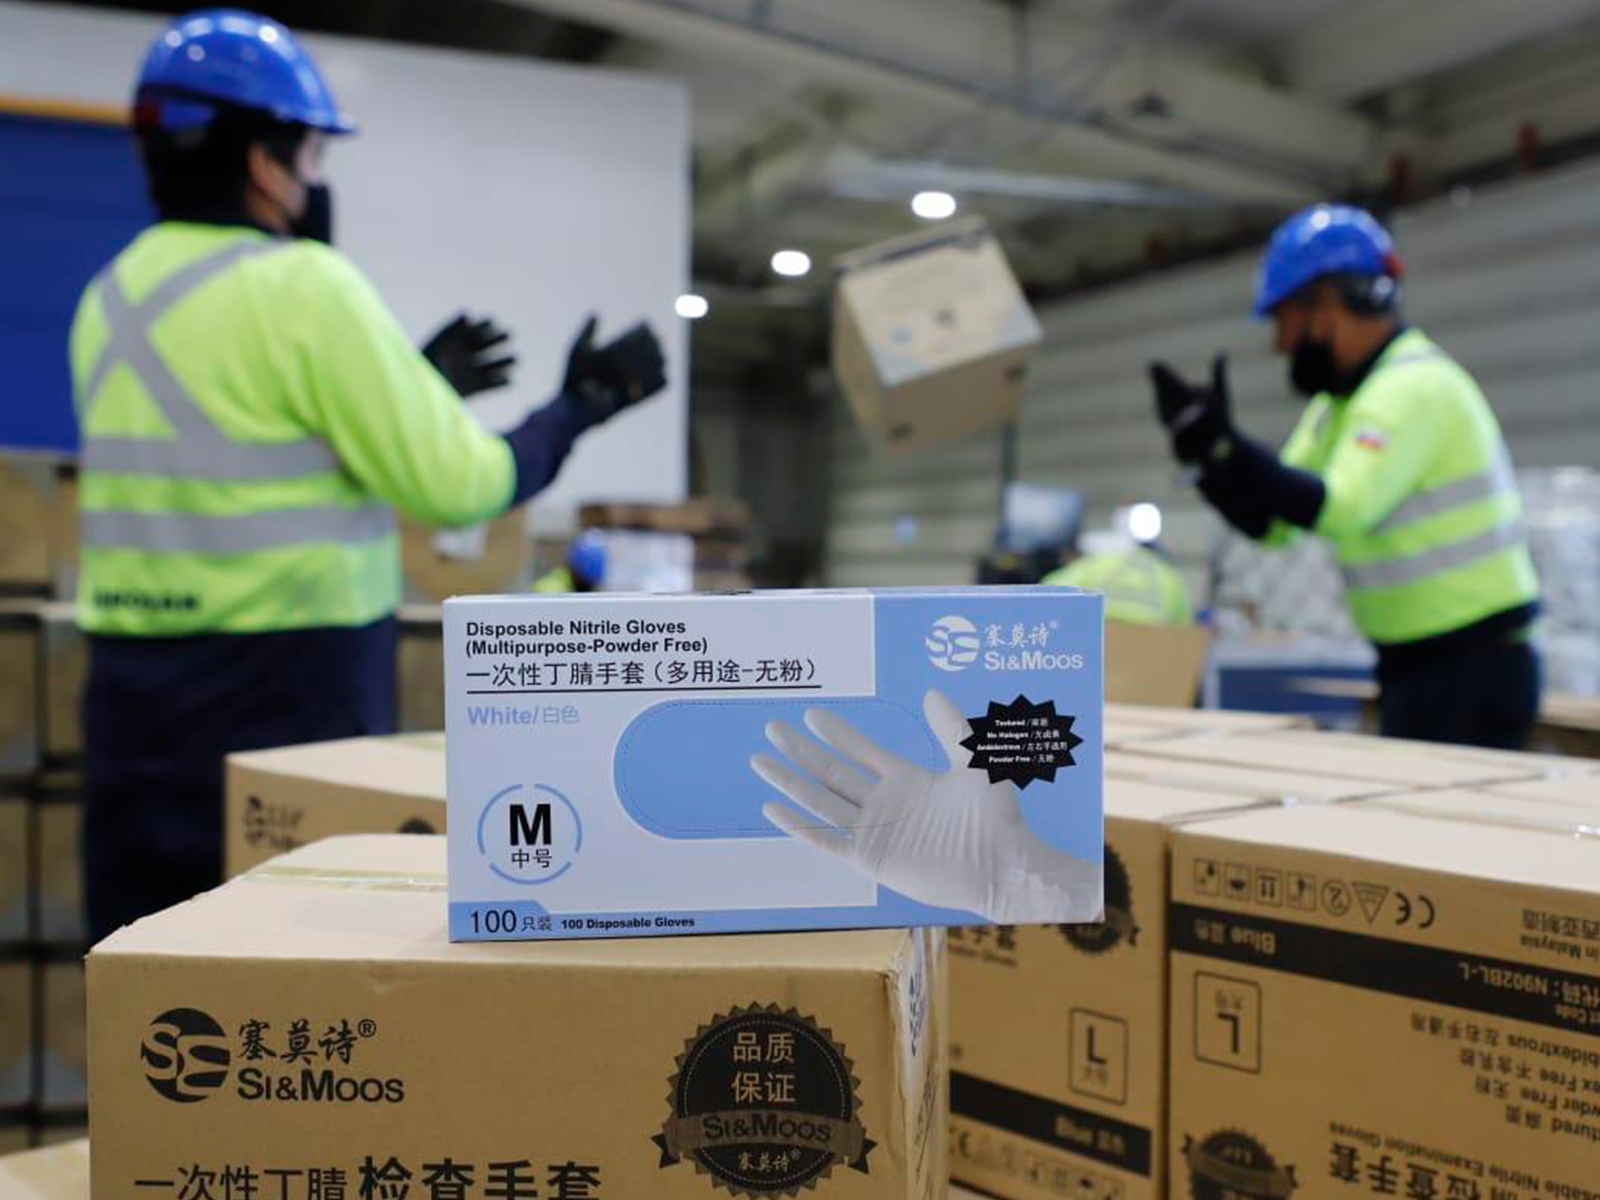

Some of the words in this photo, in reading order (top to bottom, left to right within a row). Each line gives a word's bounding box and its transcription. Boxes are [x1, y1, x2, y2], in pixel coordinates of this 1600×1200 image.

[466, 620, 564, 638] Disposable
[570, 619, 621, 635] Nitrile
[626, 619, 686, 635] Gloves
[466, 638, 659, 658] (Multipurpose-Powder
[664, 636, 708, 655] Free)
[508, 803, 553, 847] M
[511, 849, 553, 870] 中号
[470, 910, 517, 934] 100
[561, 917, 583, 931] 100
[586, 917, 652, 932] Disposable
[655, 915, 696, 930] Gloves
[1520, 933, 1582, 960] Malaysia
[1457, 961, 1549, 996] N902BL-L
[1086, 1026, 1108, 1066] L
[1216, 1010, 1240, 1055] L
[732, 1031, 796, 1065] 品质
[730, 1071, 797, 1104] 保证
[1539, 1067, 1577, 1092] Free
[1520, 1086, 1558, 1111] Free
[1384, 1136, 1484, 1178] Examination
[1488, 1163, 1541, 1192] Nitrile
